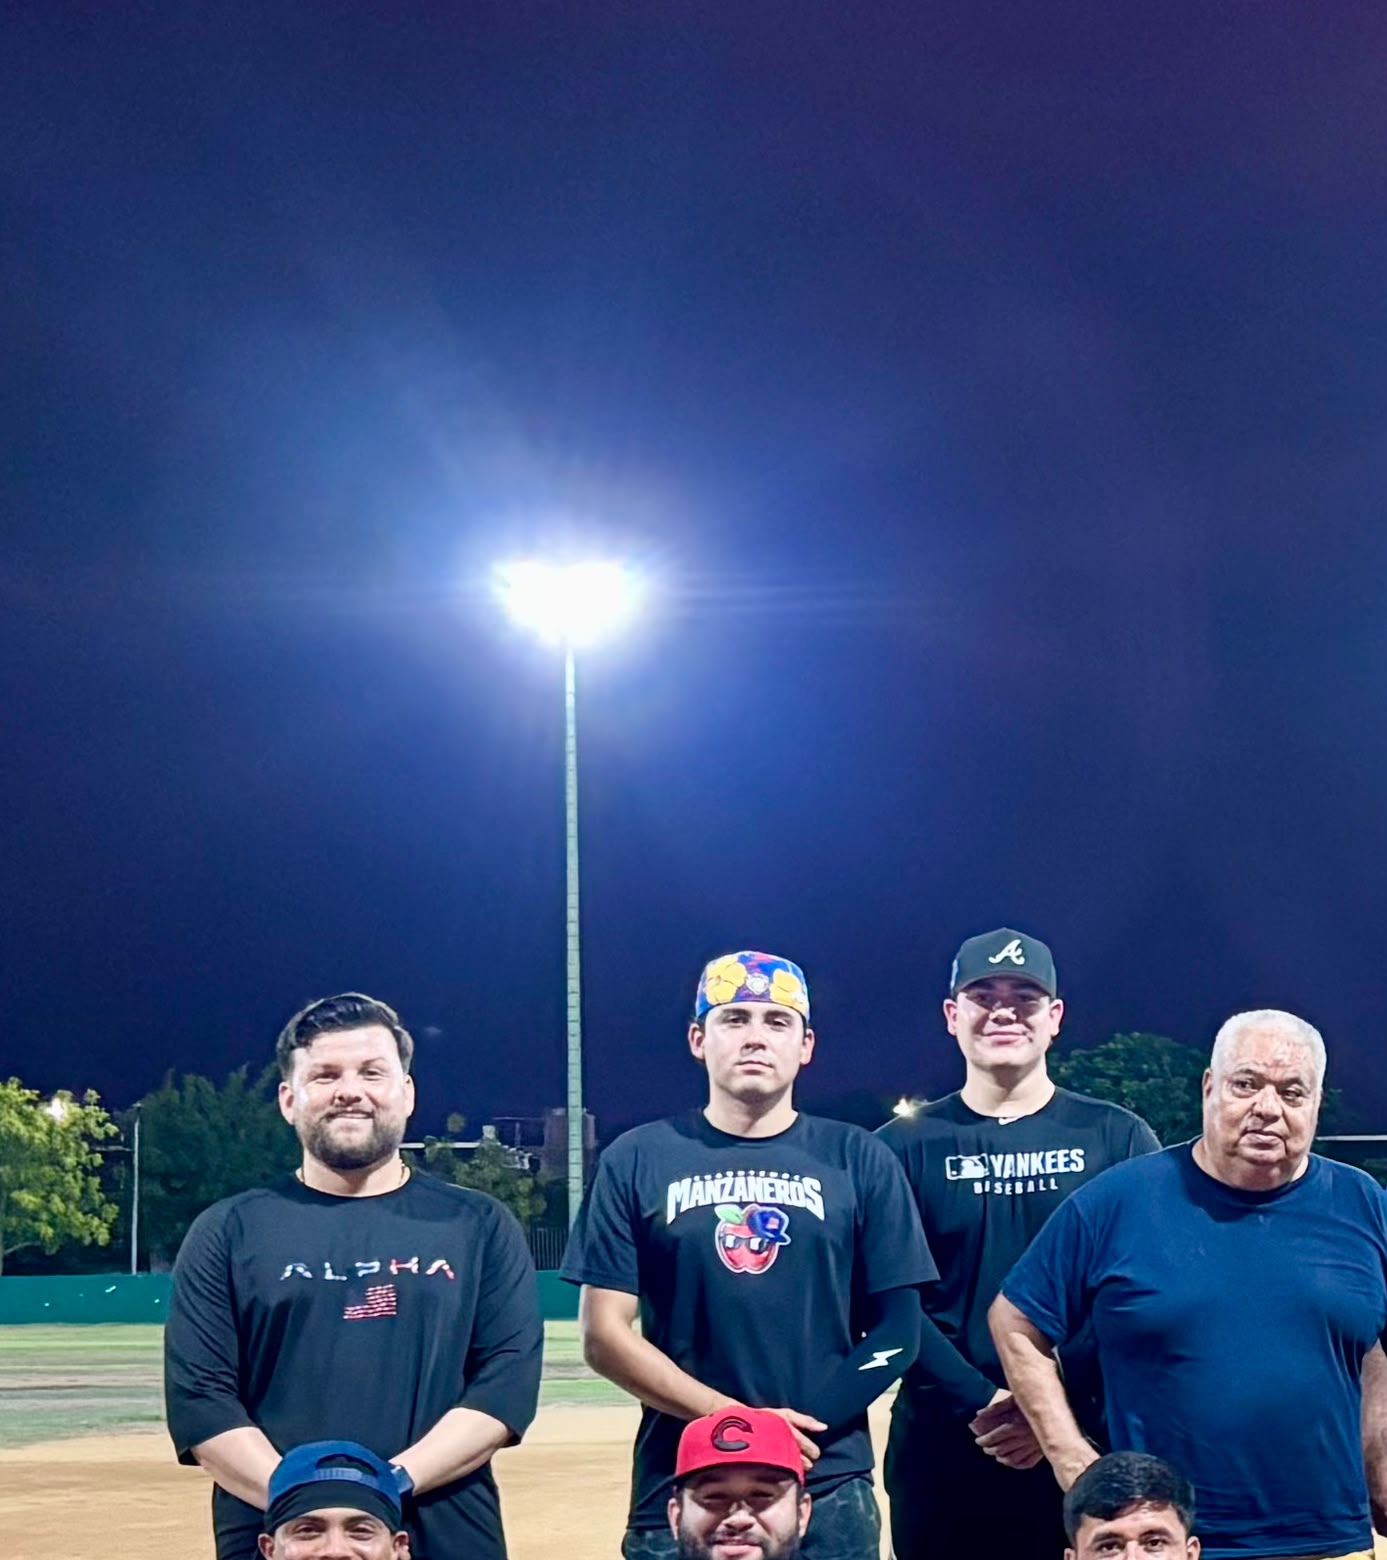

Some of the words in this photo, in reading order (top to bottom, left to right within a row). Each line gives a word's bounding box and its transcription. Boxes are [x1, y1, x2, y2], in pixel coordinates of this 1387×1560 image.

[987, 939, 1025, 965] A
[989, 1148, 1085, 1179] YANKEES
[666, 1176, 825, 1224] MANZANEROS
[279, 1256, 456, 1281] ALPHA
[710, 1416, 754, 1452] C
